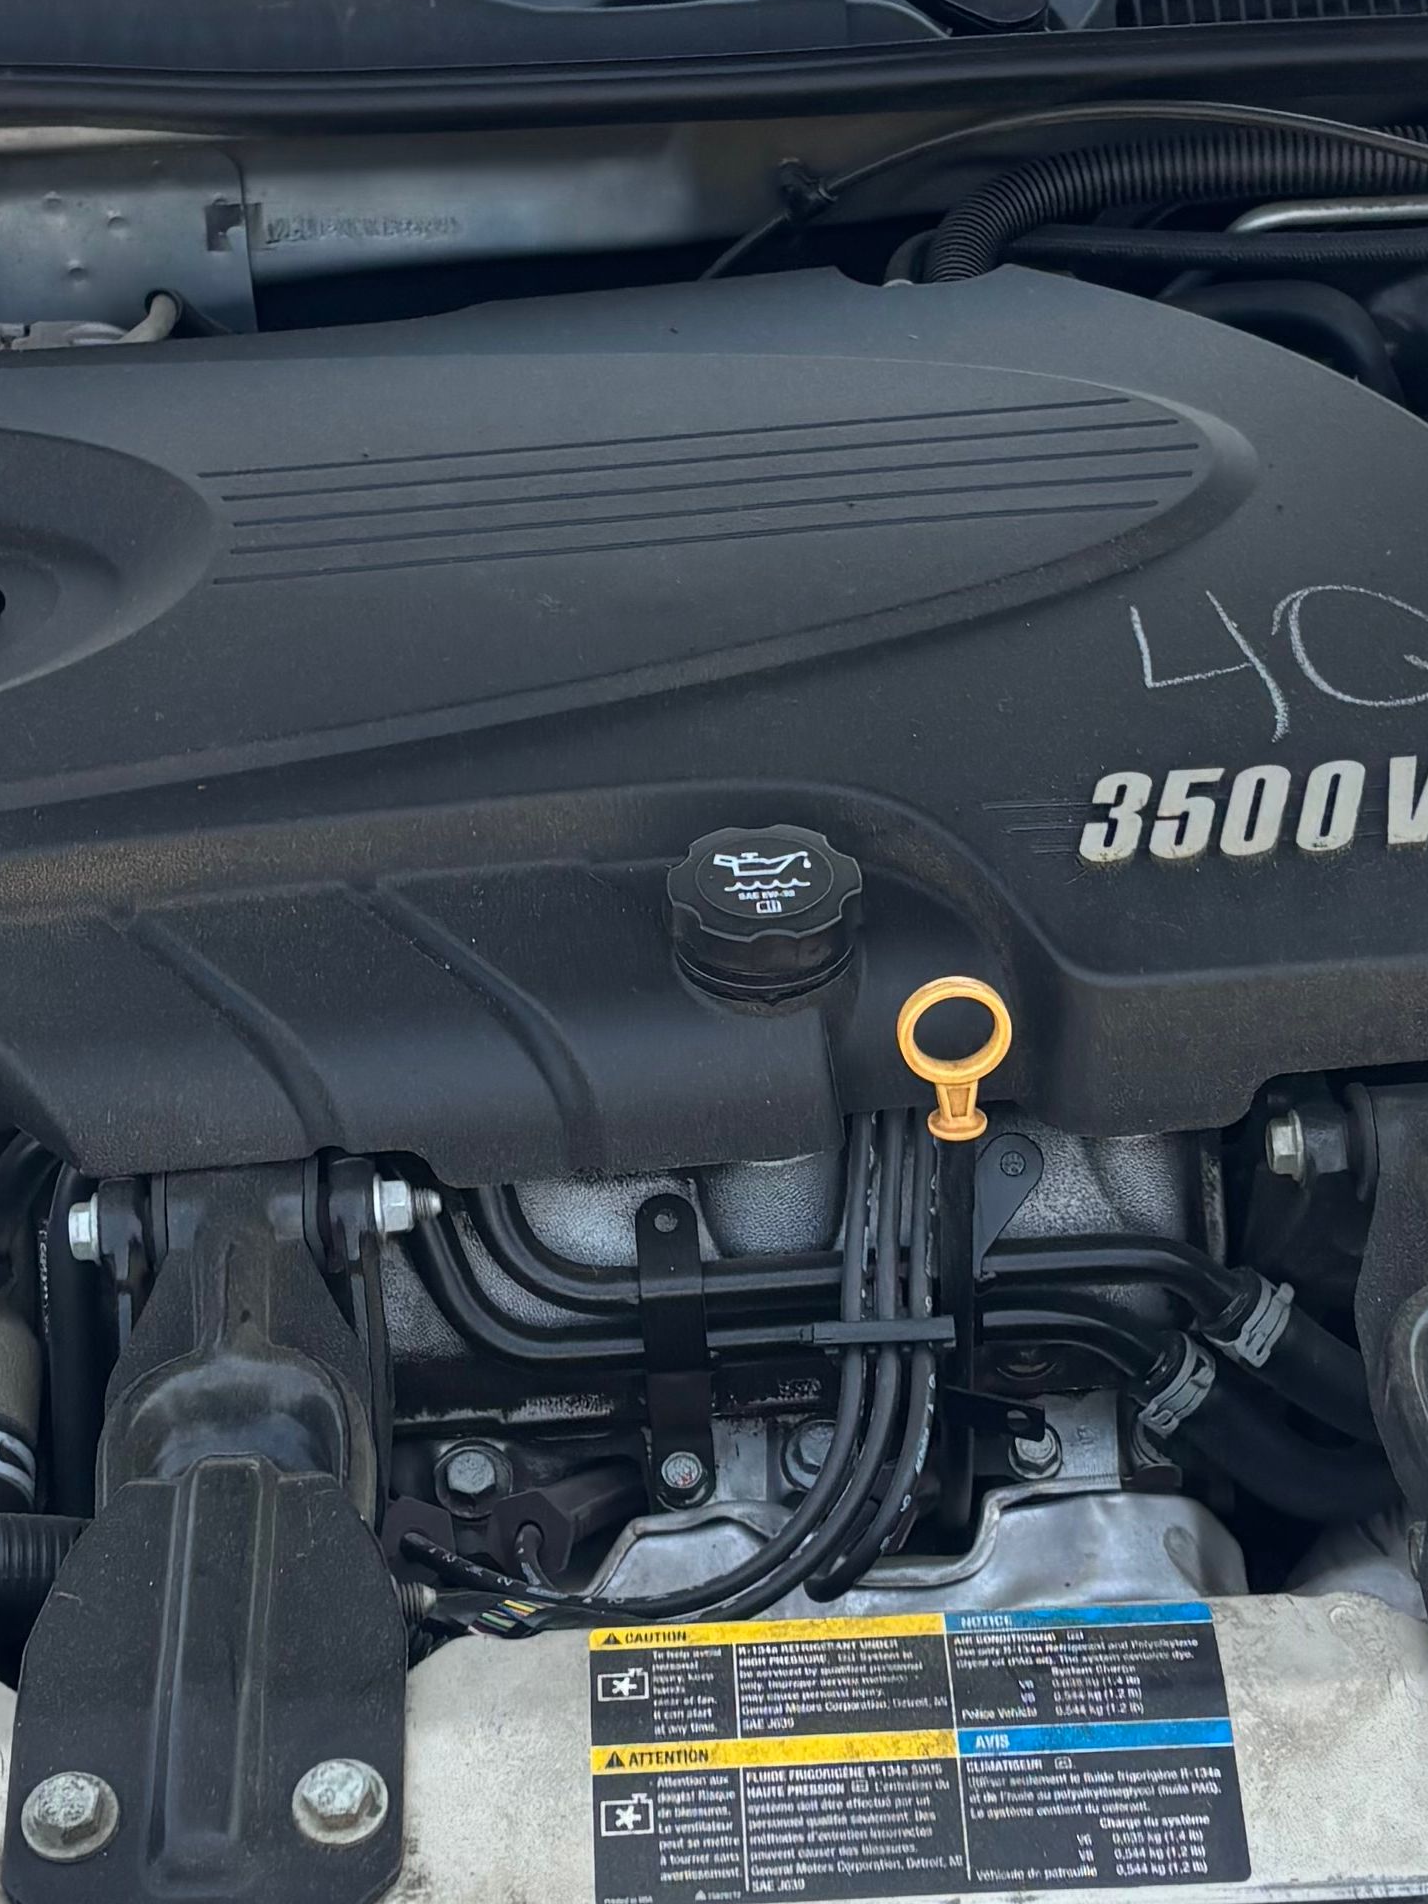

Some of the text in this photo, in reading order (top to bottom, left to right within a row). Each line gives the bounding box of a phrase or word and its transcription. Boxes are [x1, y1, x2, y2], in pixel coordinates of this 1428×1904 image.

[1078, 760, 1367, 863] 3500
[961, 1615, 1012, 1628] NOTICE
[625, 1631, 687, 1644] CAUTION
[954, 1636, 973, 1646] AIR
[741, 1703, 784, 1715] General
[785, 1702, 823, 1714] Motors
[975, 1734, 1010, 1750] AVIS
[628, 1749, 709, 1767] ATTENTION
[966, 1758, 1043, 1773] CLIMATISEUR
[657, 1775, 707, 1788] Attention
[746, 1770, 787, 1784] FLUIDE
[867, 1764, 909, 1778] R-134a
[911, 1763, 943, 1776] SOUS
[1070, 1772, 1081, 1784] le
[1180, 1767, 1222, 1780] R-134a
[698, 1789, 736, 1803] Risque
[746, 1785, 785, 1799] HAUTE
[787, 1782, 845, 1797] PRESSION
[894, 1797, 913, 1809] par
[915, 1795, 931, 1807] un
[970, 1807, 985, 1820] Le
[986, 1806, 1034, 1821] système
[1036, 1804, 1082, 1817] contient
[1084, 1803, 1100, 1814] du
[658, 1823, 672, 1835] Le
[748, 1815, 804, 1832] personnel
[914, 1810, 937, 1822] Des
[1099, 1814, 1210, 1830] Charge du système
[702, 1835, 740, 1848] mettre
[1147, 1832, 1162, 1845] kg
[1188, 1829, 1204, 1842] lb)
[750, 1848, 795, 1863] peuvent
[798, 1847, 835, 1859] causer
[1078, 1849, 1095, 1862] V8
[1148, 1846, 1164, 1860] kg
[1190, 1844, 1206, 1858] lb)
[751, 1863, 793, 1877] General
[795, 1862, 834, 1875] Motors
[906, 1856, 947, 1869] Detroit,
[975, 1868, 1025, 1882] Véhicule
[1044, 1864, 1098, 1880] patrouille
[1150, 1862, 1166, 1877] kg
[1192, 1859, 1208, 1874] lb)
[752, 1879, 775, 1893] SAE
